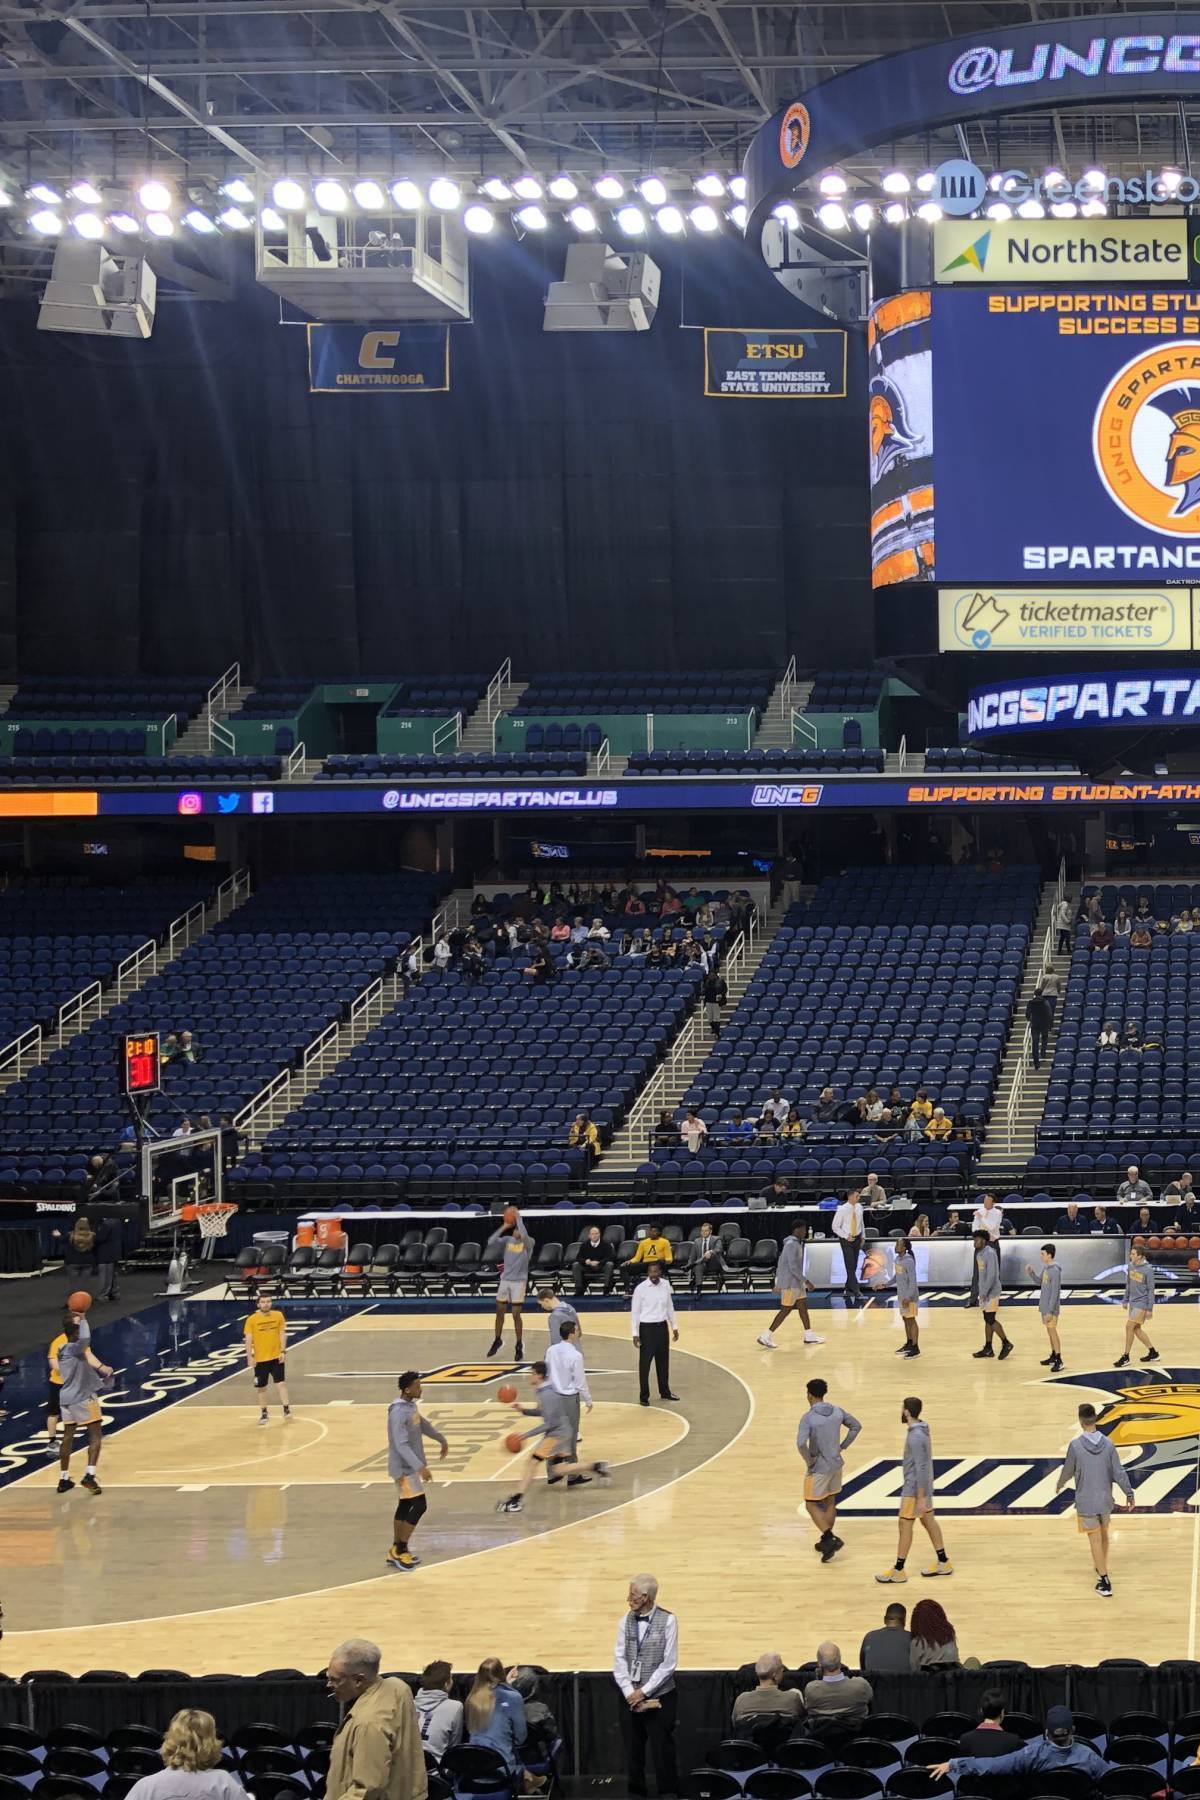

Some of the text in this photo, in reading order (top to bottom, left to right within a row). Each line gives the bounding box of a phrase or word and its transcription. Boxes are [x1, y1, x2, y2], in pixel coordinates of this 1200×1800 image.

[1007, 237, 1182, 264] NorthState
[988, 294, 1147, 313] SUPPORTING
[1058, 316, 1178, 335] SUCCESS
[359, 331, 400, 368] C
[746, 343, 804, 359] ETSU
[336, 374, 424, 385] CHATTANOOGA
[726, 371, 826, 381] EAST TENNESSEE
[720, 382, 831, 393] STATE UNIVERSITY
[1109, 417, 1132, 485] UNCG
[1019, 601, 1160, 622] ticketmaster
[1019, 625, 1153, 638] VERIFIED TICKETS
[382, 789, 618, 809] @UNCGSPARTANCLUB
[751, 784, 823, 806] UNCG
[907, 785, 1045, 802] SUPPORTING
[36, 1202, 77, 1212] SPALDING
